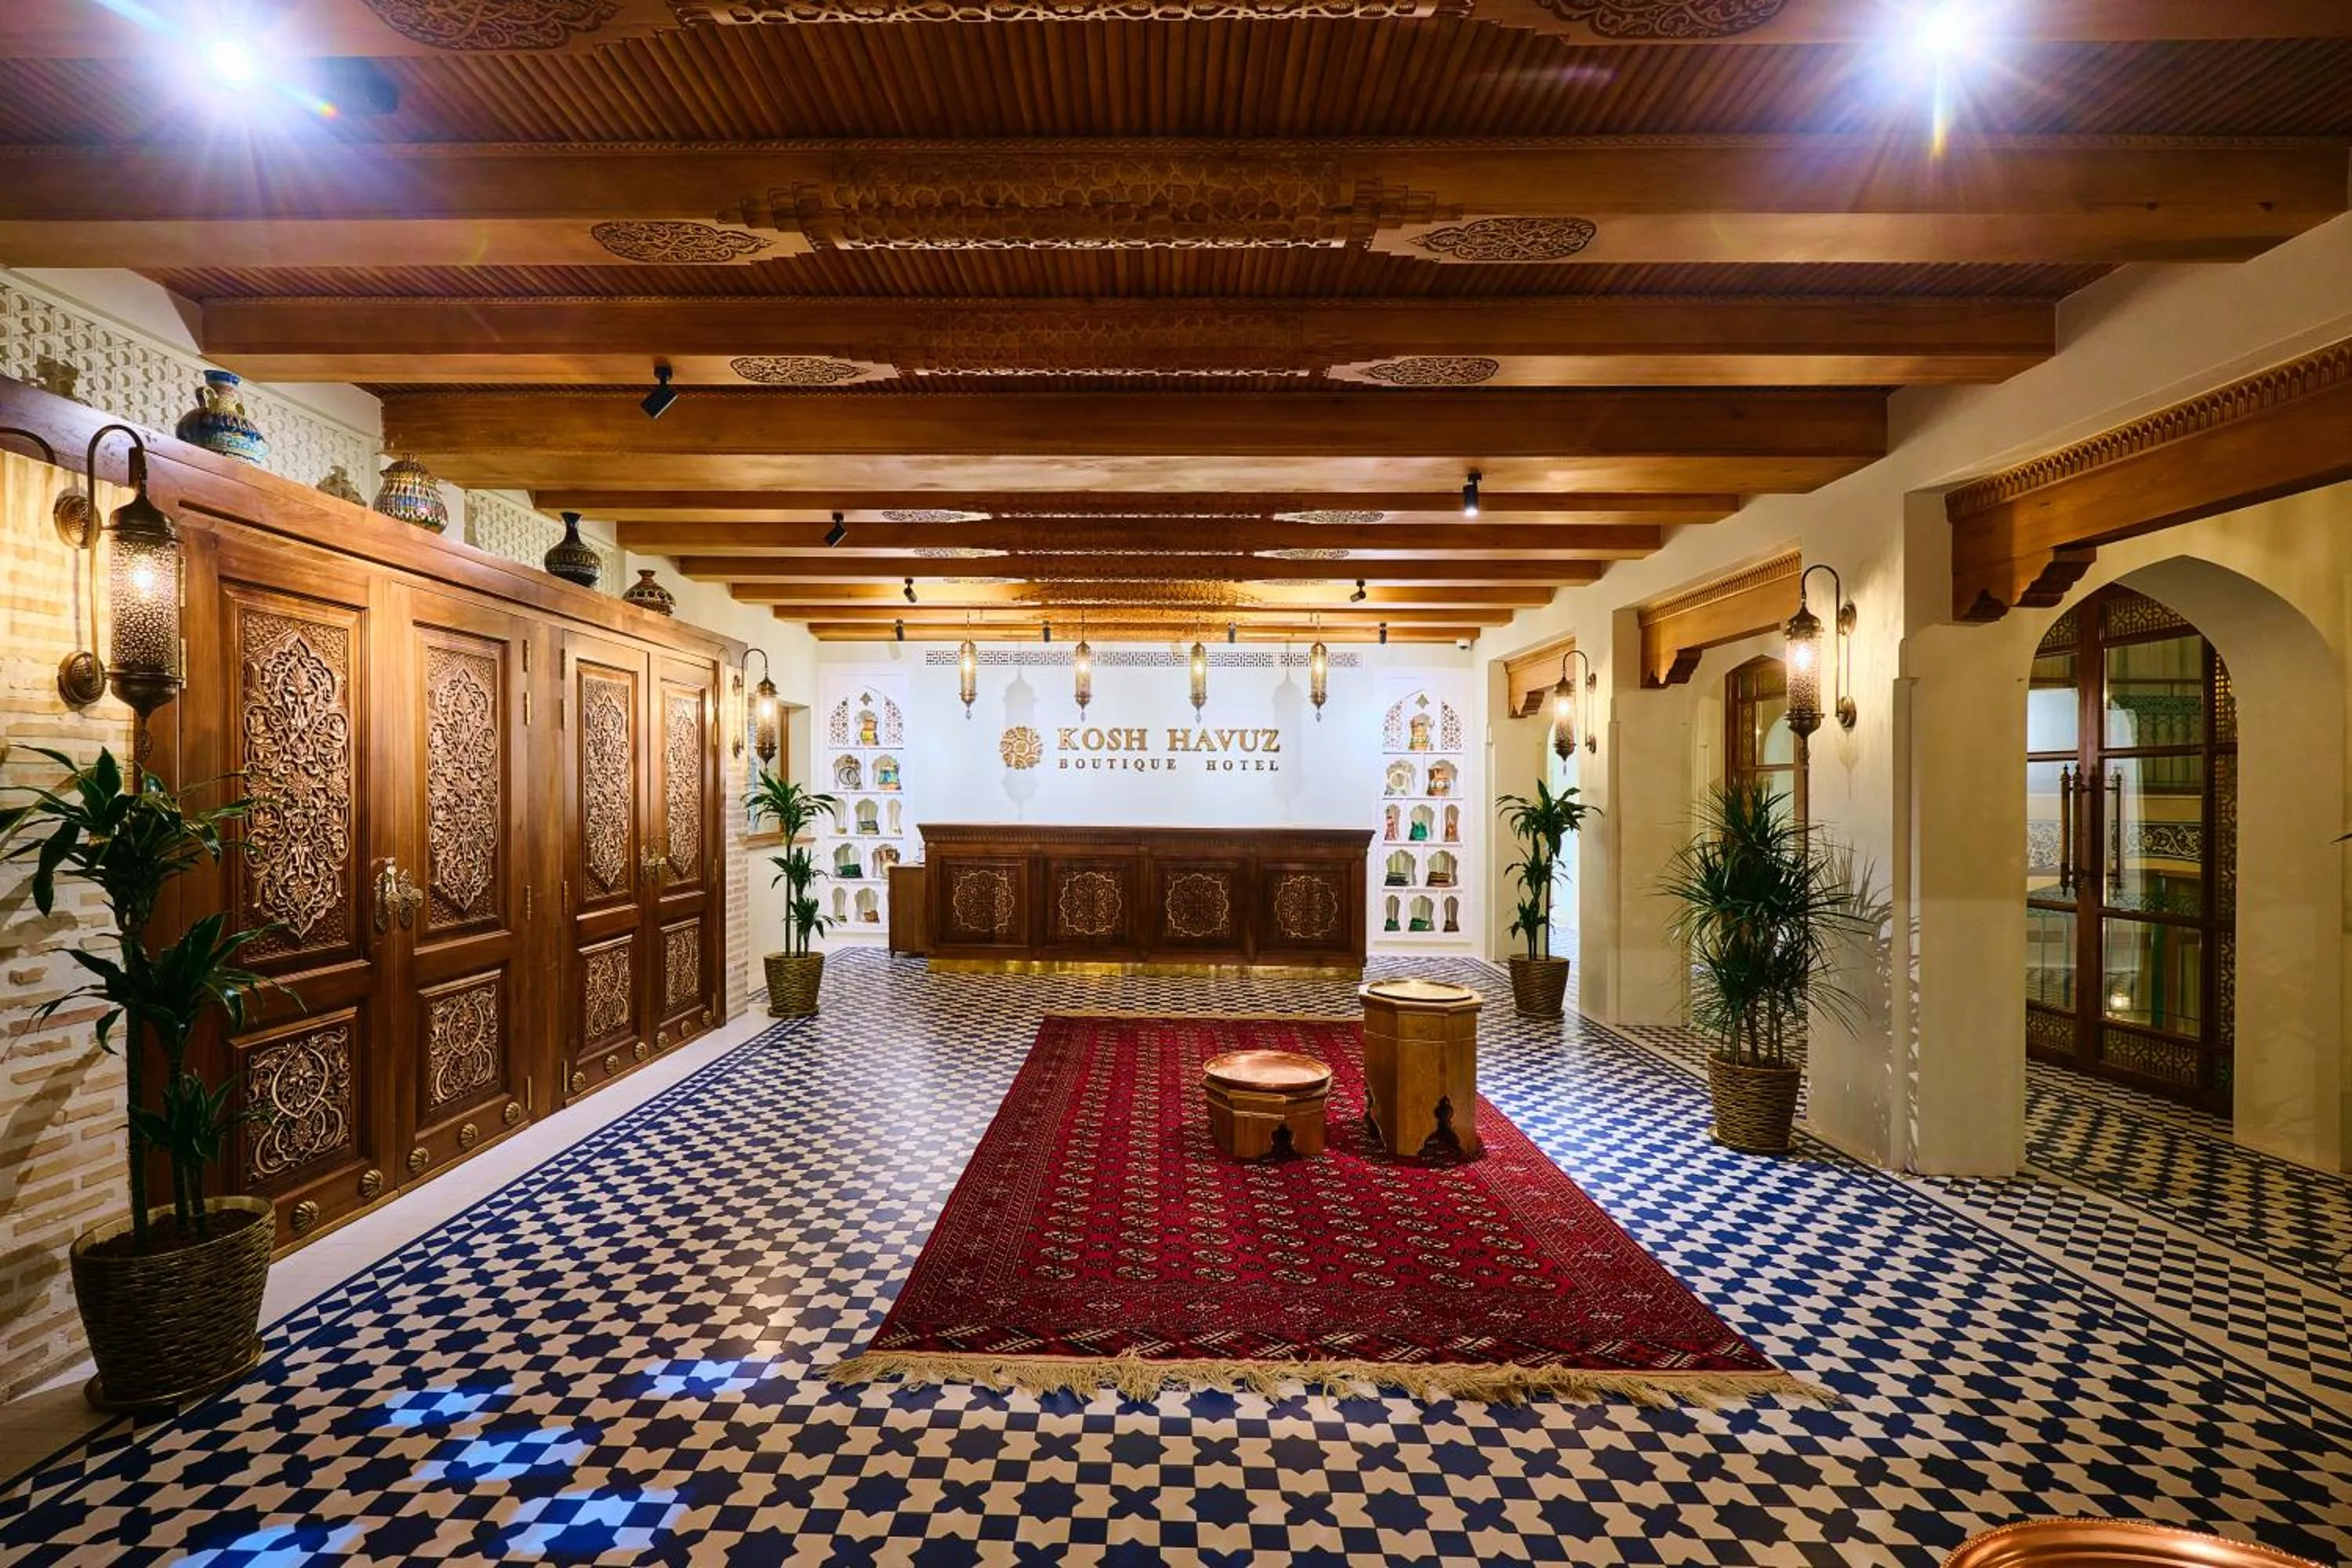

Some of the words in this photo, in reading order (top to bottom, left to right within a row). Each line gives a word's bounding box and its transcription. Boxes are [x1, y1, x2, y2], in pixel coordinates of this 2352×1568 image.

[1058, 728, 1149, 751] KOSH
[1167, 728, 1281, 753] HAVUZ
[1058, 758, 1177, 771] BOUTIQUE
[1206, 760, 1279, 771] HOTEL
